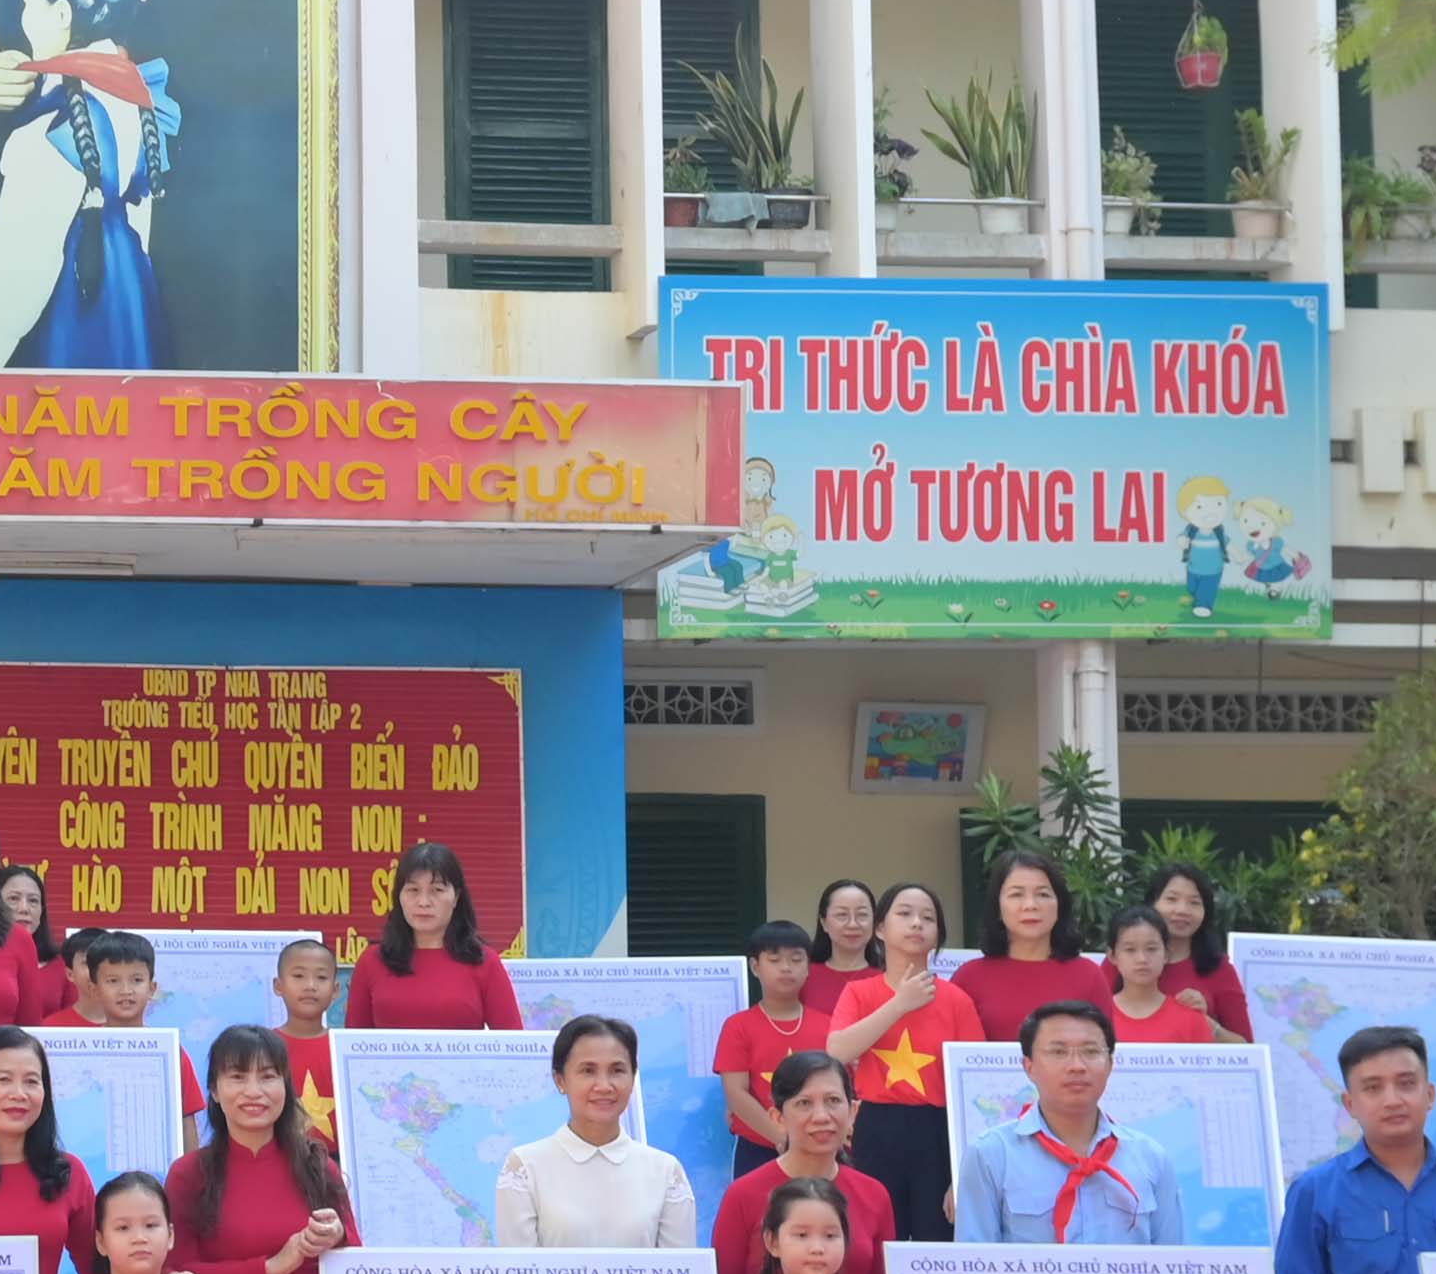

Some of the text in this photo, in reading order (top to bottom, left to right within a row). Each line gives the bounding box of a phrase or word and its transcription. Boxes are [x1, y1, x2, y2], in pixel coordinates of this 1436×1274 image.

[704, 324, 1286, 415] TRI THỨC LÀ CHÌA KHÓA
[158, 383, 418, 441] TRỒNG
[449, 392, 590, 443] CÂY
[131, 444, 386, 502] TRỒNG
[415, 450, 646, 505] NGƯỜI
[816, 445, 1166, 543] MỞ TƯƠNG LAI
[102, 693, 362, 734] TRƯỜNG TIỂU HỌC TÂN LẬP 2
[143, 669, 328, 699] UBND TP NHA TRANG
[58, 723, 152, 789] TRUYỀN
[171, 726, 219, 790] CHỦ
[244, 724, 323, 790] QUYỀN
[350, 722, 405, 791] BIỂN
[432, 725, 479, 792] ĐẢO
[59, 792, 403, 853] CÔNG TRÌNH MĂNG NON
[71, 853, 122, 914] HÀO
[152, 857, 206, 921] MỘT
[236, 851, 275, 914] DẢI
[299, 867, 350, 916] NON
